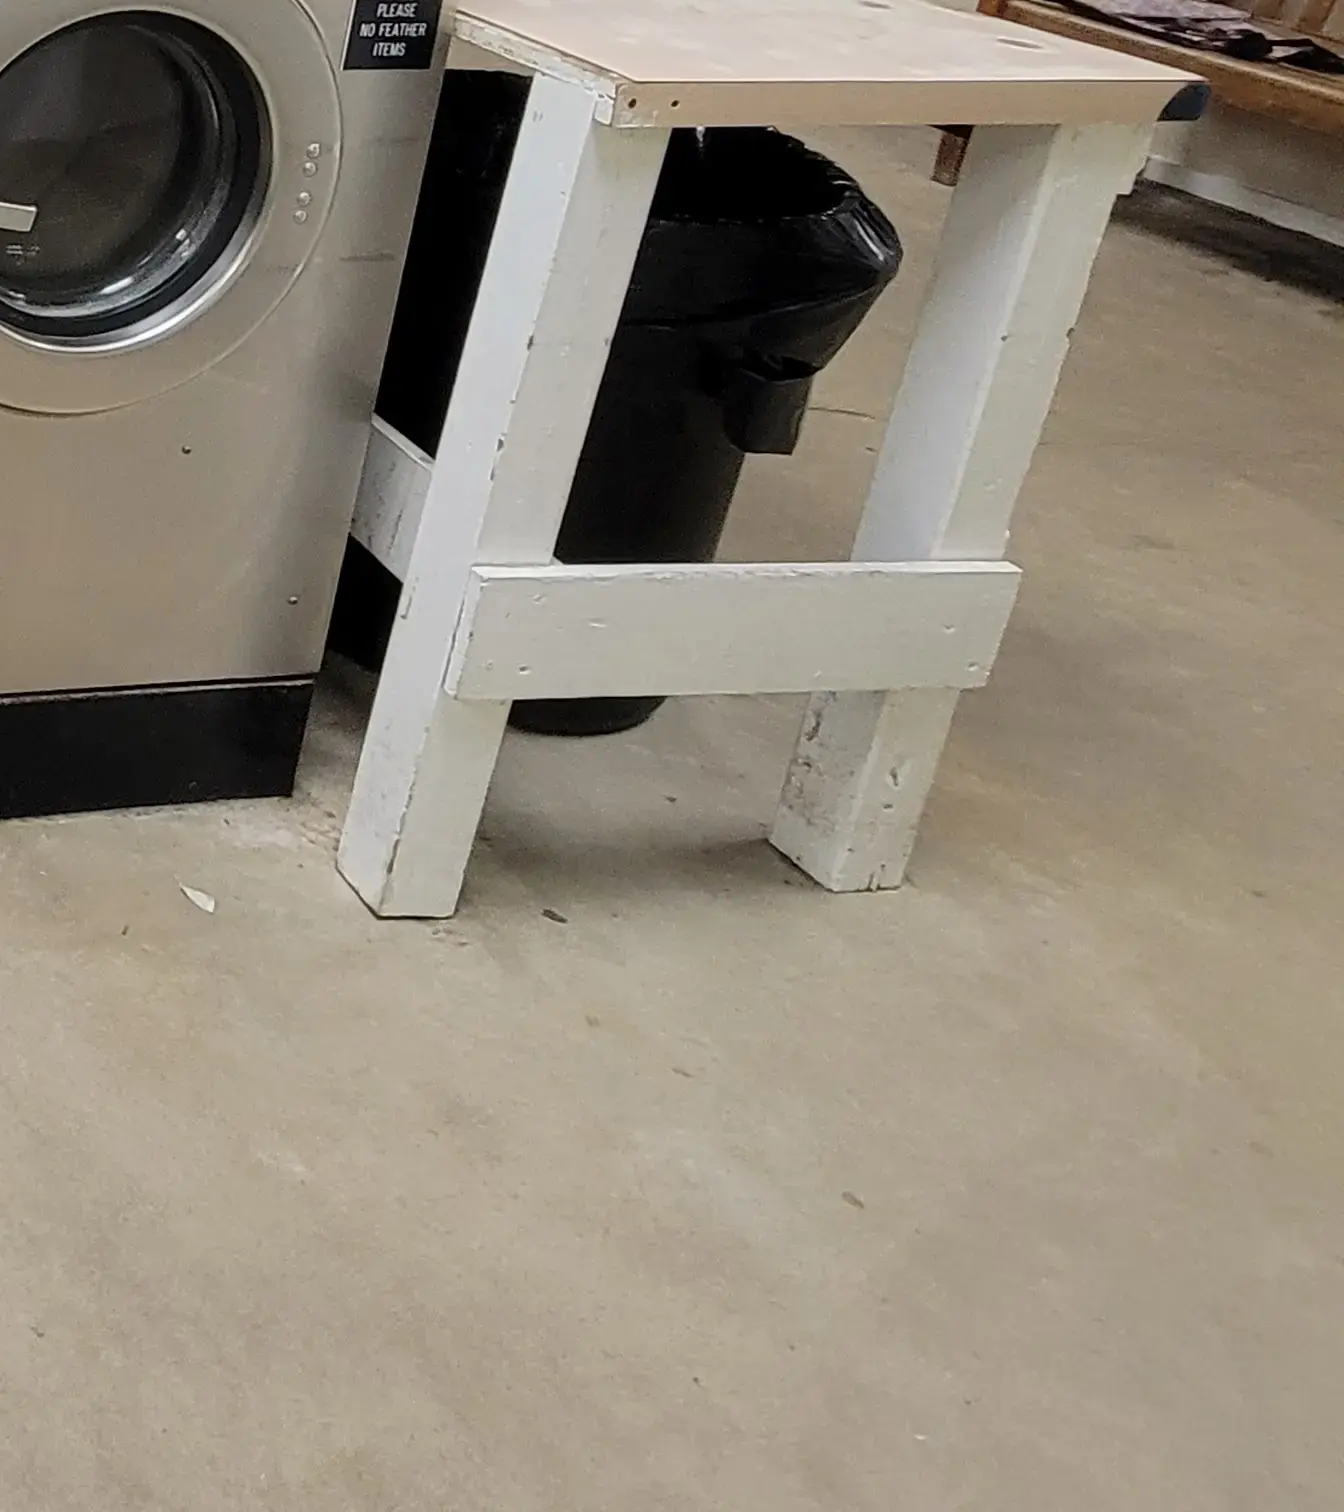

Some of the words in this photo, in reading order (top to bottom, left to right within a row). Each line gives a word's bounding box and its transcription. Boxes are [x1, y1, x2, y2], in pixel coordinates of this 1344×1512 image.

[376, 3, 418, 18] PLEASE
[359, 23, 376, 37] NO
[378, 23, 427, 37] FEATHER
[372, 42, 406, 57] ITEMS
